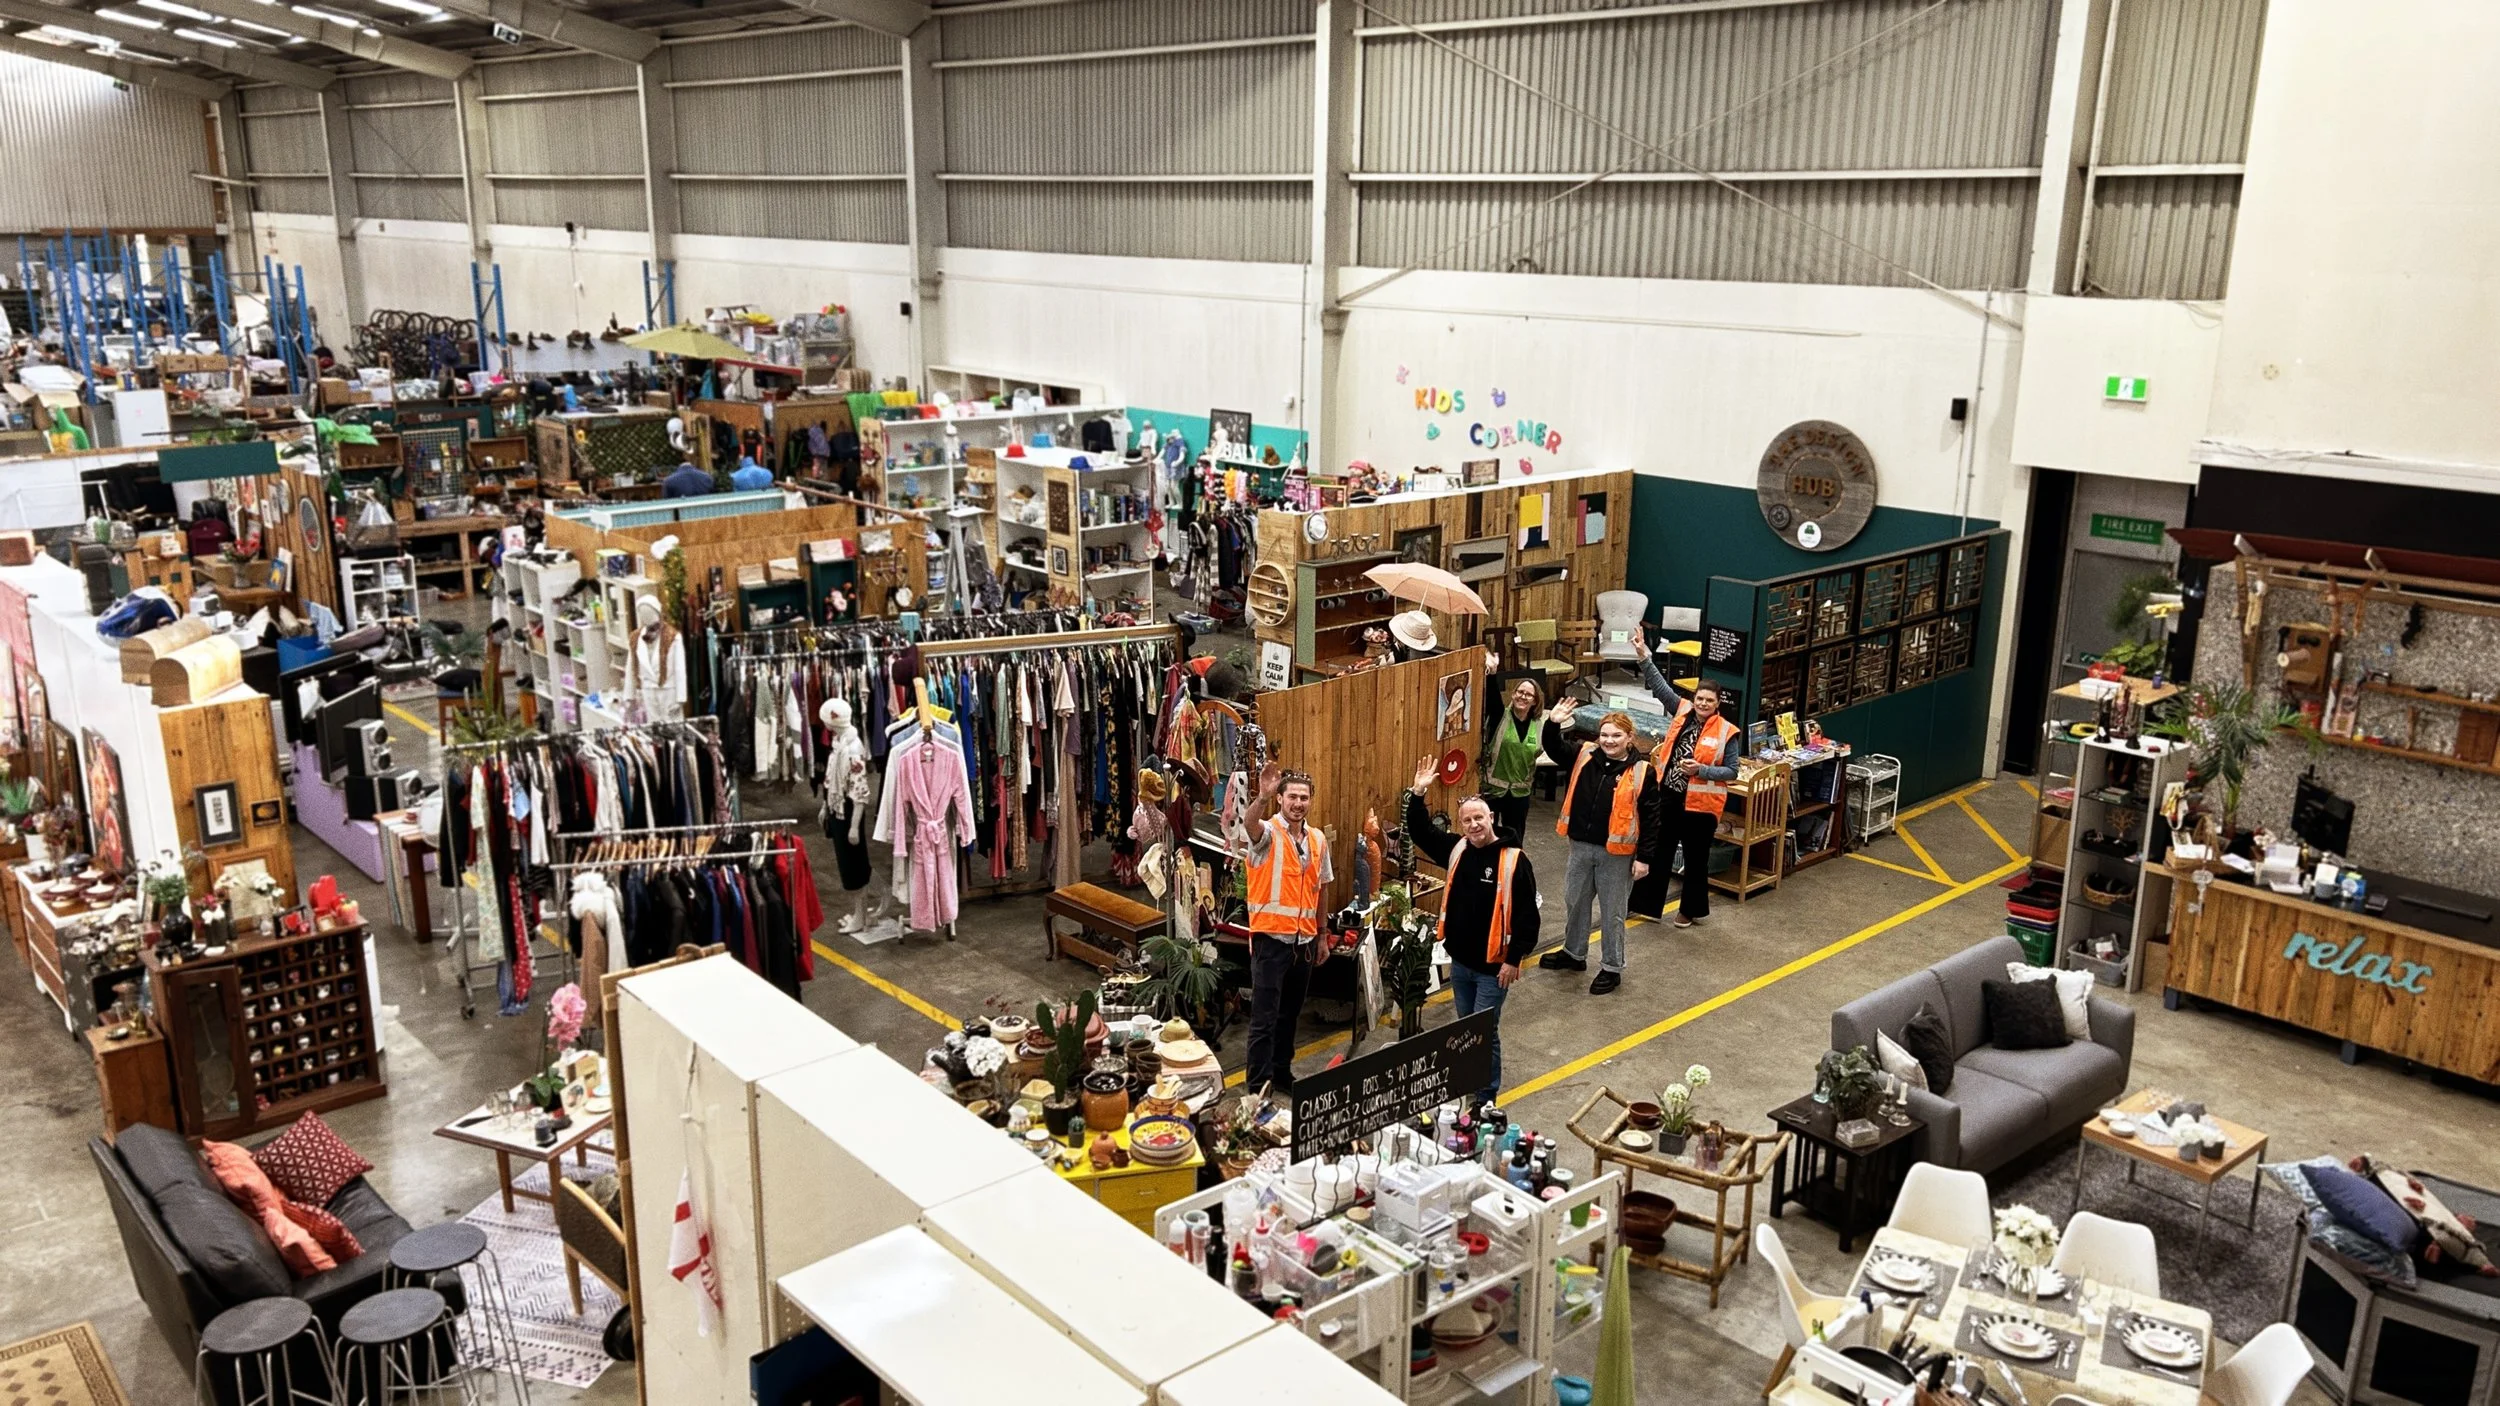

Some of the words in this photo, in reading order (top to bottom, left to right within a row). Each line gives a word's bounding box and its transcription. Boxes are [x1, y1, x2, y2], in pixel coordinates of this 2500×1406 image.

[1415, 387, 1465, 413] KIDS
[1470, 419, 1562, 454] CORNER
[1768, 436, 1800, 467] THE
[1803, 430, 1865, 477] DESIGN
[1792, 476, 1835, 497] HUB
[2102, 518, 2125, 531] FIRE
[2129, 522, 2154, 534] EXIT
[1265, 671, 1283, 682] CALM
[1266, 661, 1284, 672] KEEP
[2282, 931, 2433, 994] relax
[1300, 1090, 1338, 1120] GLASSES
[1363, 1074, 1379, 1096] POTS
[1410, 1055, 1427, 1077] JARS
